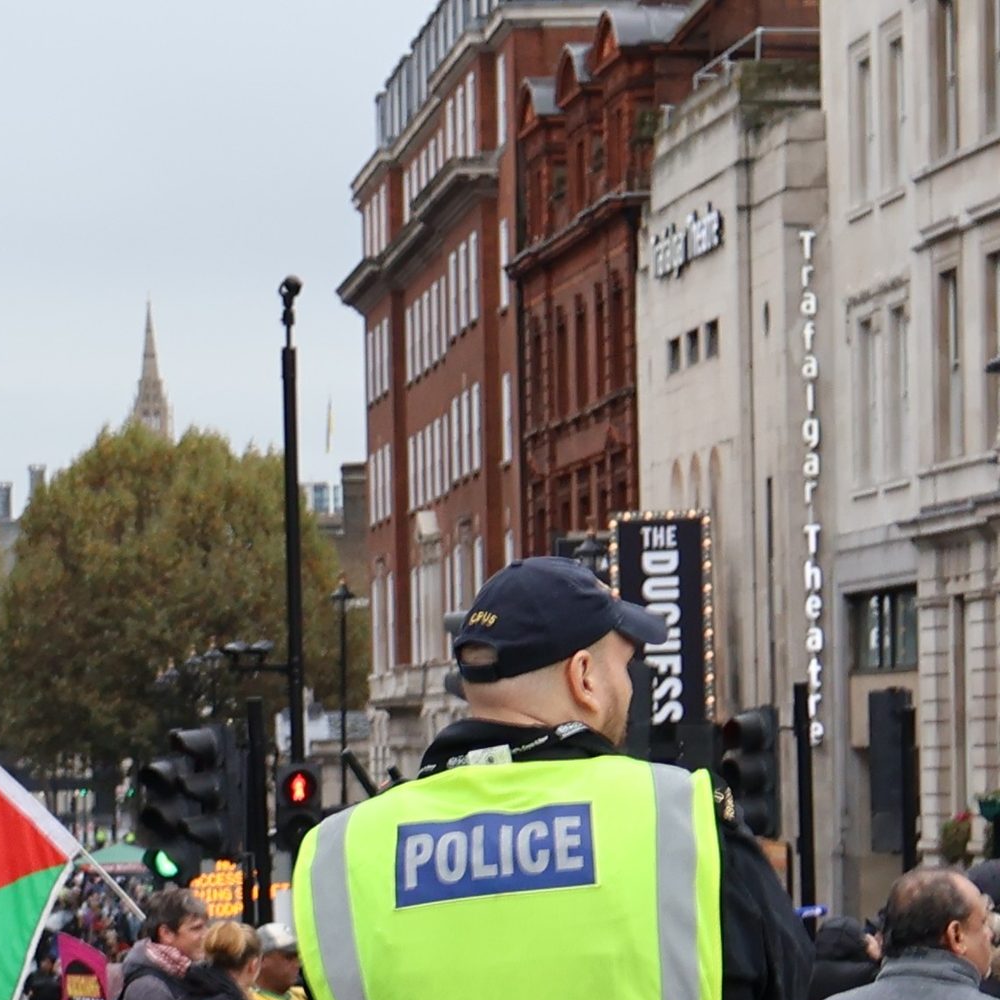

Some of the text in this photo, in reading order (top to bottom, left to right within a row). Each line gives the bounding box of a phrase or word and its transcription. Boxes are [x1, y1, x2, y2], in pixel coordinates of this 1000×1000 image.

[799, 230, 825, 745] Trafalgar Theatre
[641, 525, 678, 549] THE
[404, 815, 585, 891] POLICE
